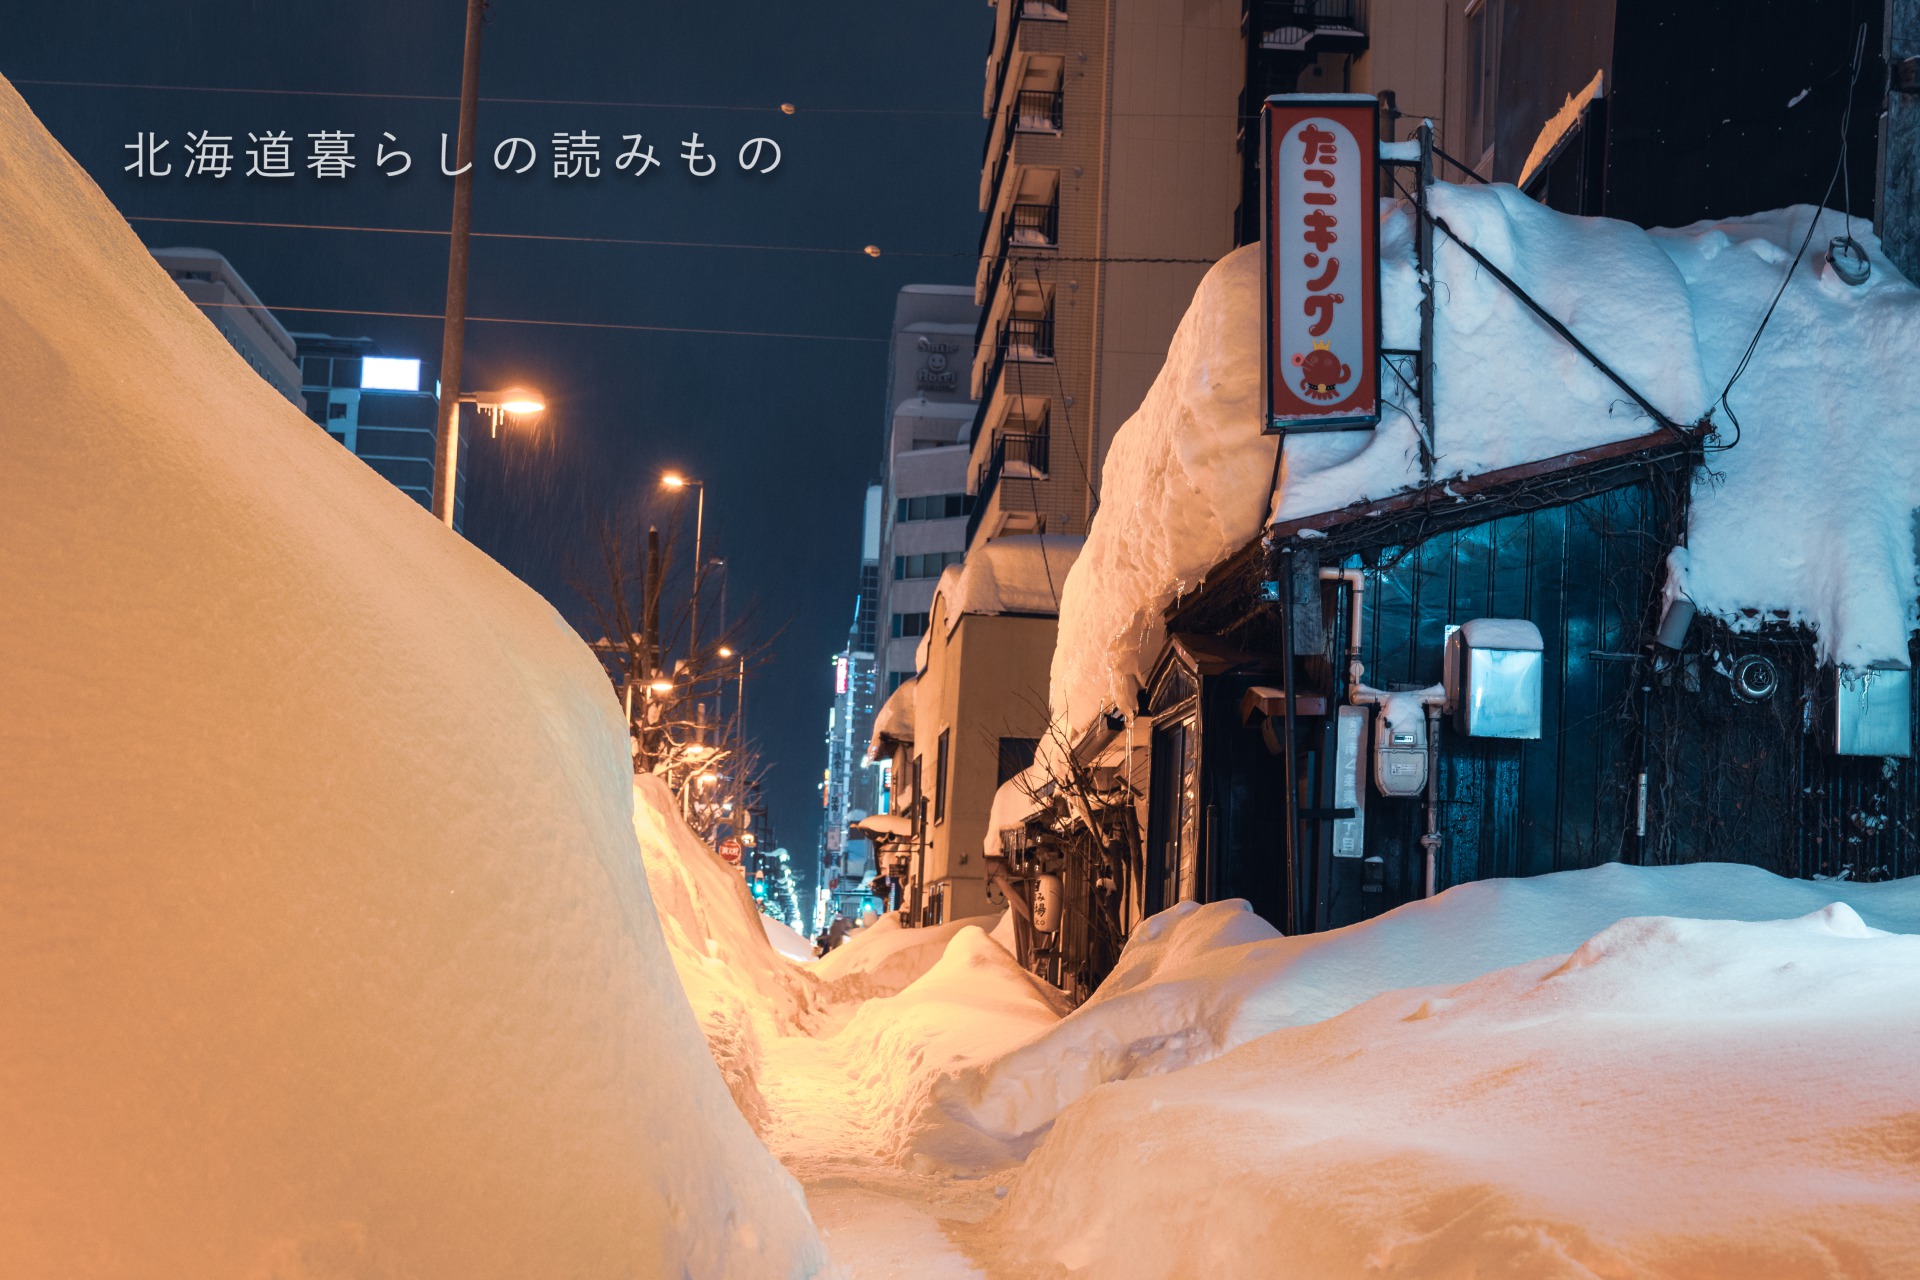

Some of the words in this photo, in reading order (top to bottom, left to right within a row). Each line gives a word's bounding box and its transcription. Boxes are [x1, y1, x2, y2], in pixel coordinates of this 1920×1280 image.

[1298, 123, 1344, 337] たこキング
[917, 339, 959, 353] Smile
[917, 369, 957, 383] Hotel
[1342, 742, 1357, 851] 南4条東丁目
